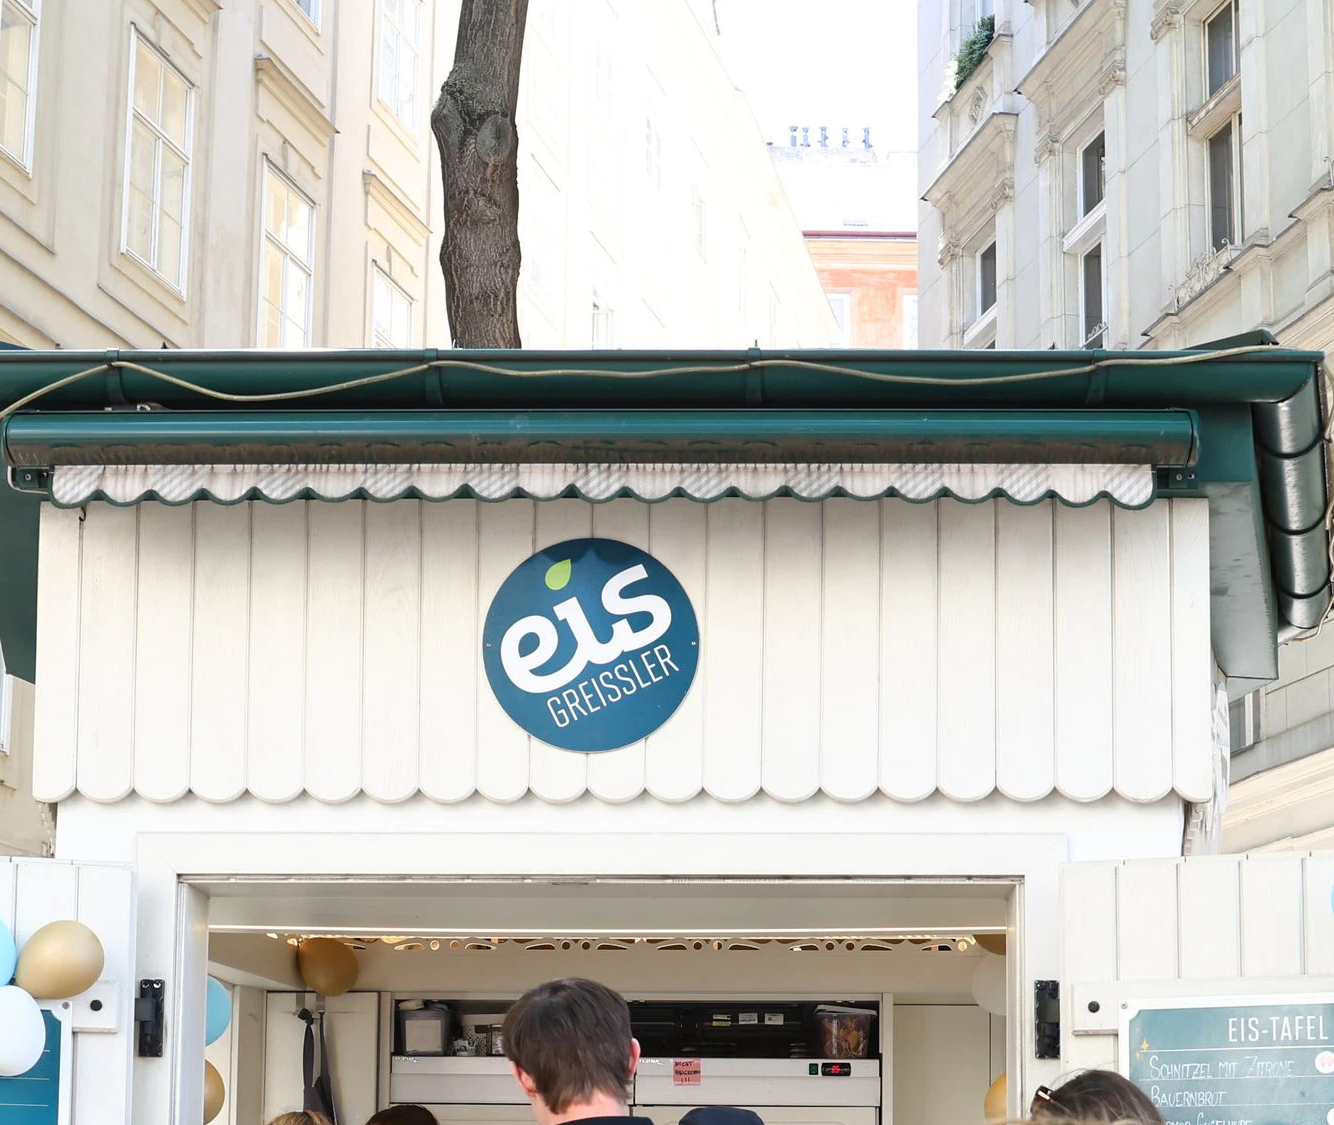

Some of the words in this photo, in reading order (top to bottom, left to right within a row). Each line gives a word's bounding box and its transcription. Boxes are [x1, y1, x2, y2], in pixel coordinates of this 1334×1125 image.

[500, 559, 672, 694] eis
[547, 644, 679, 728] GREISSLER
[1228, 1015, 1329, 1042] EIS-TAFEL
[1218, 1061, 1237, 1078] MIT
